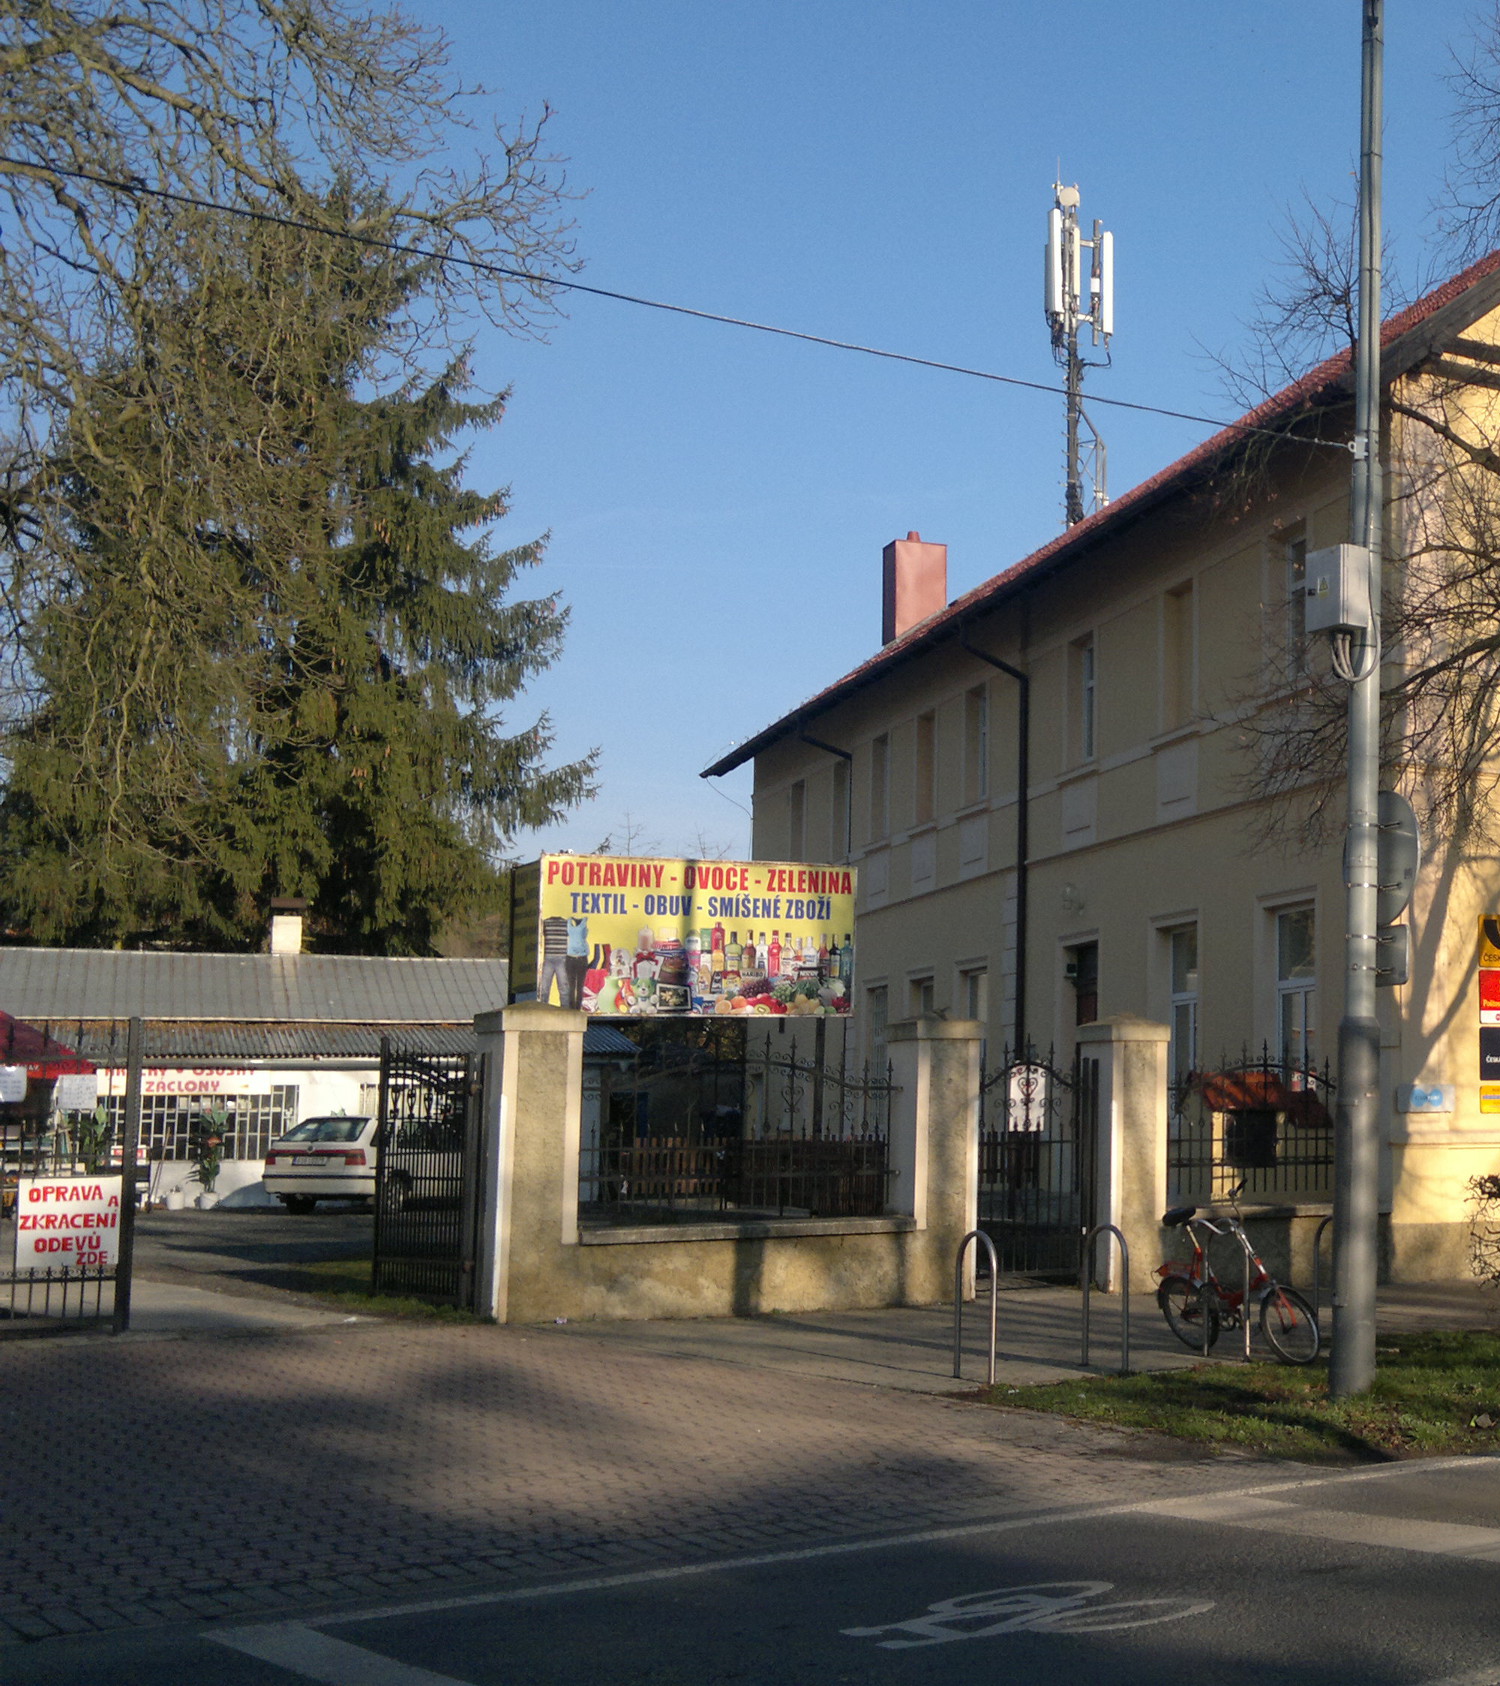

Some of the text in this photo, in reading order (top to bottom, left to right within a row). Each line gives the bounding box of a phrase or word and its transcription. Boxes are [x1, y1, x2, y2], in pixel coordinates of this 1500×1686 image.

[547, 860, 665, 889] POTRAVINY
[683, 865, 749, 891] OVOCE
[766, 868, 853, 895] ZELENINA
[570, 892, 628, 915] TEXTIL
[644, 894, 693, 917] OBUV
[708, 893, 781, 919] SMÍŠENÉ
[785, 896, 832, 921] ZBOŽÍ
[28, 1185, 119, 1208] OPRAVA A
[76, 1251, 108, 1266] ZDE
